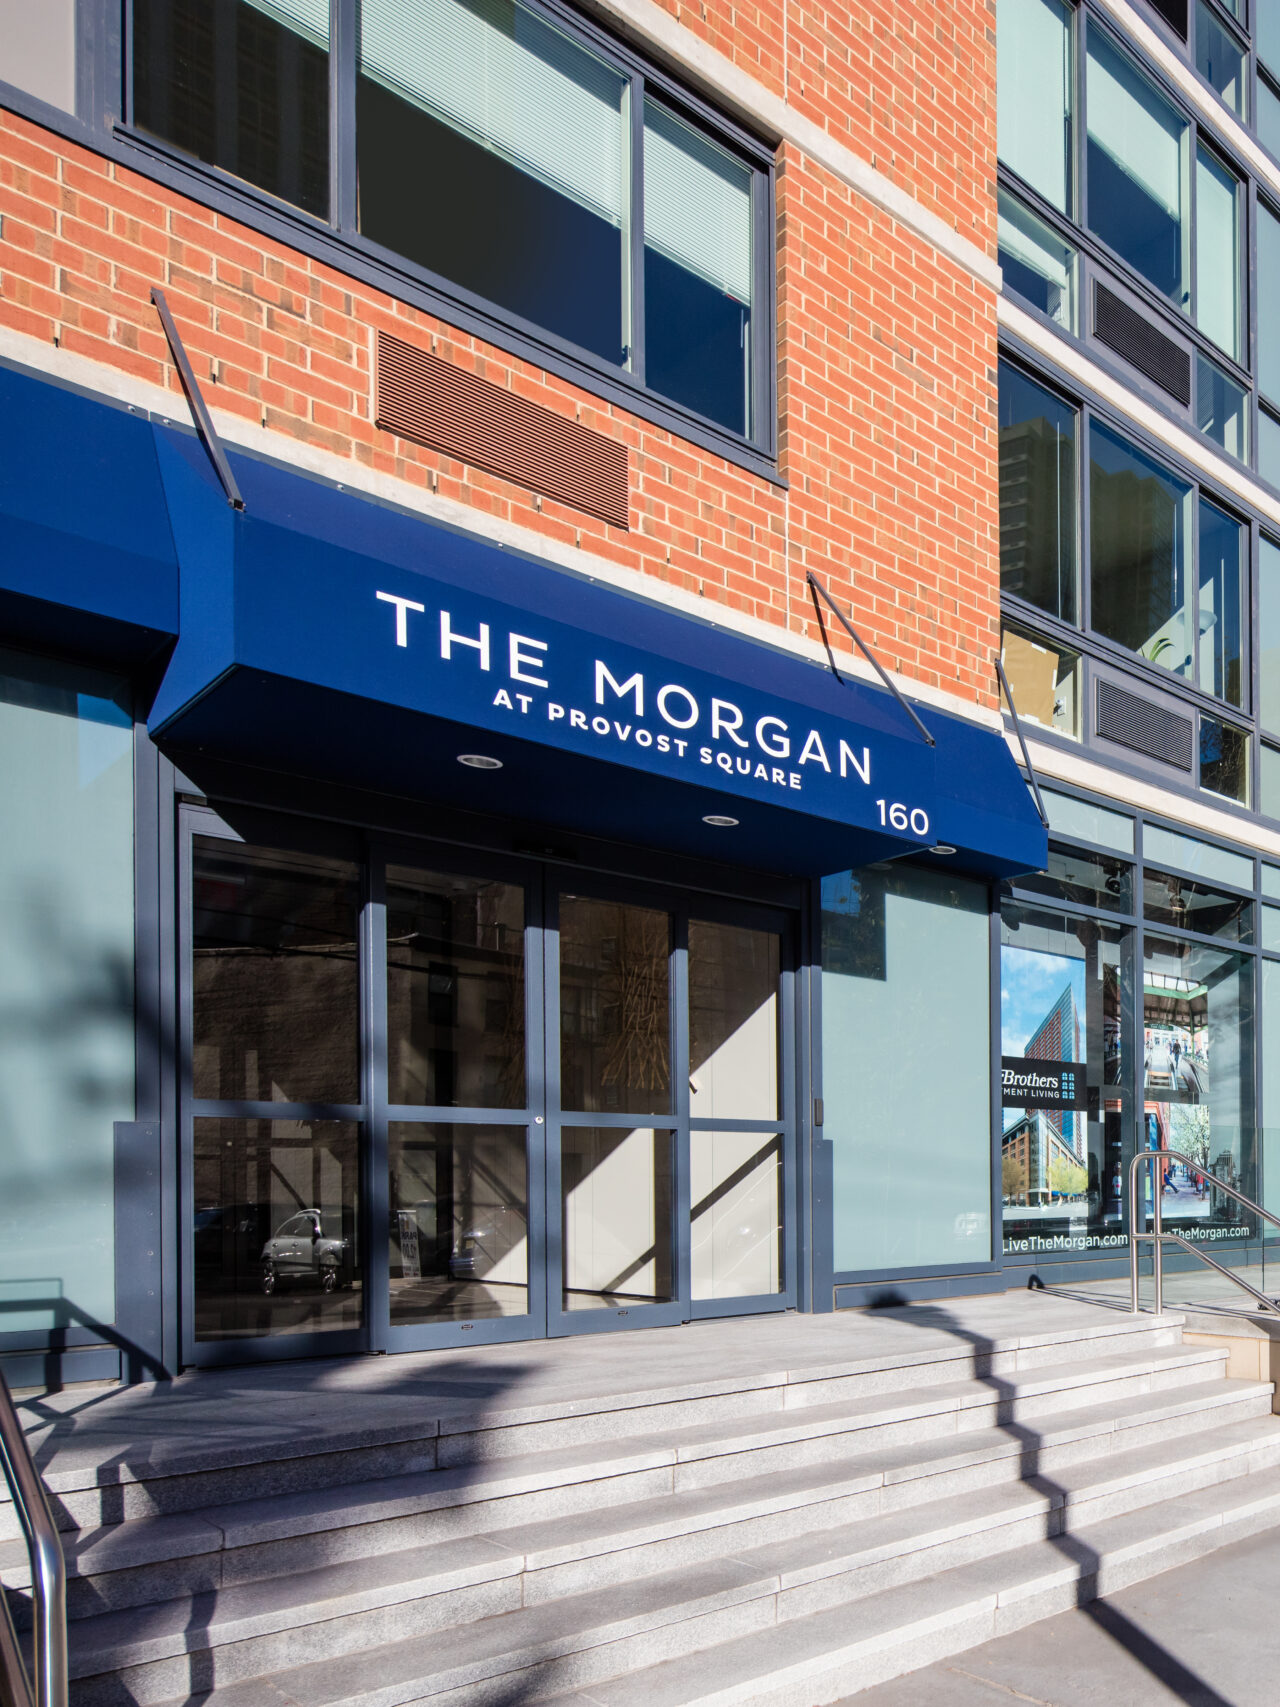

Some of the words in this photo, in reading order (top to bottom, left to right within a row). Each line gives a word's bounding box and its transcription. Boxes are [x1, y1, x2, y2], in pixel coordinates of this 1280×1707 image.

[376, 591, 549, 688] THE
[596, 660, 871, 784] MORGAN
[493, 689, 533, 713] AT
[549, 703, 688, 756] PROVOST
[700, 747, 802, 789] SQUARE
[876, 799, 929, 836] 160
[1002, 1087, 1028, 1097] MENT
[1031, 1089, 1060, 1099] LIVING
[1002, 1234, 1128, 1252] LiveTheMorgan.com
[1150, 1226, 1250, 1241] TheMorgan.com
